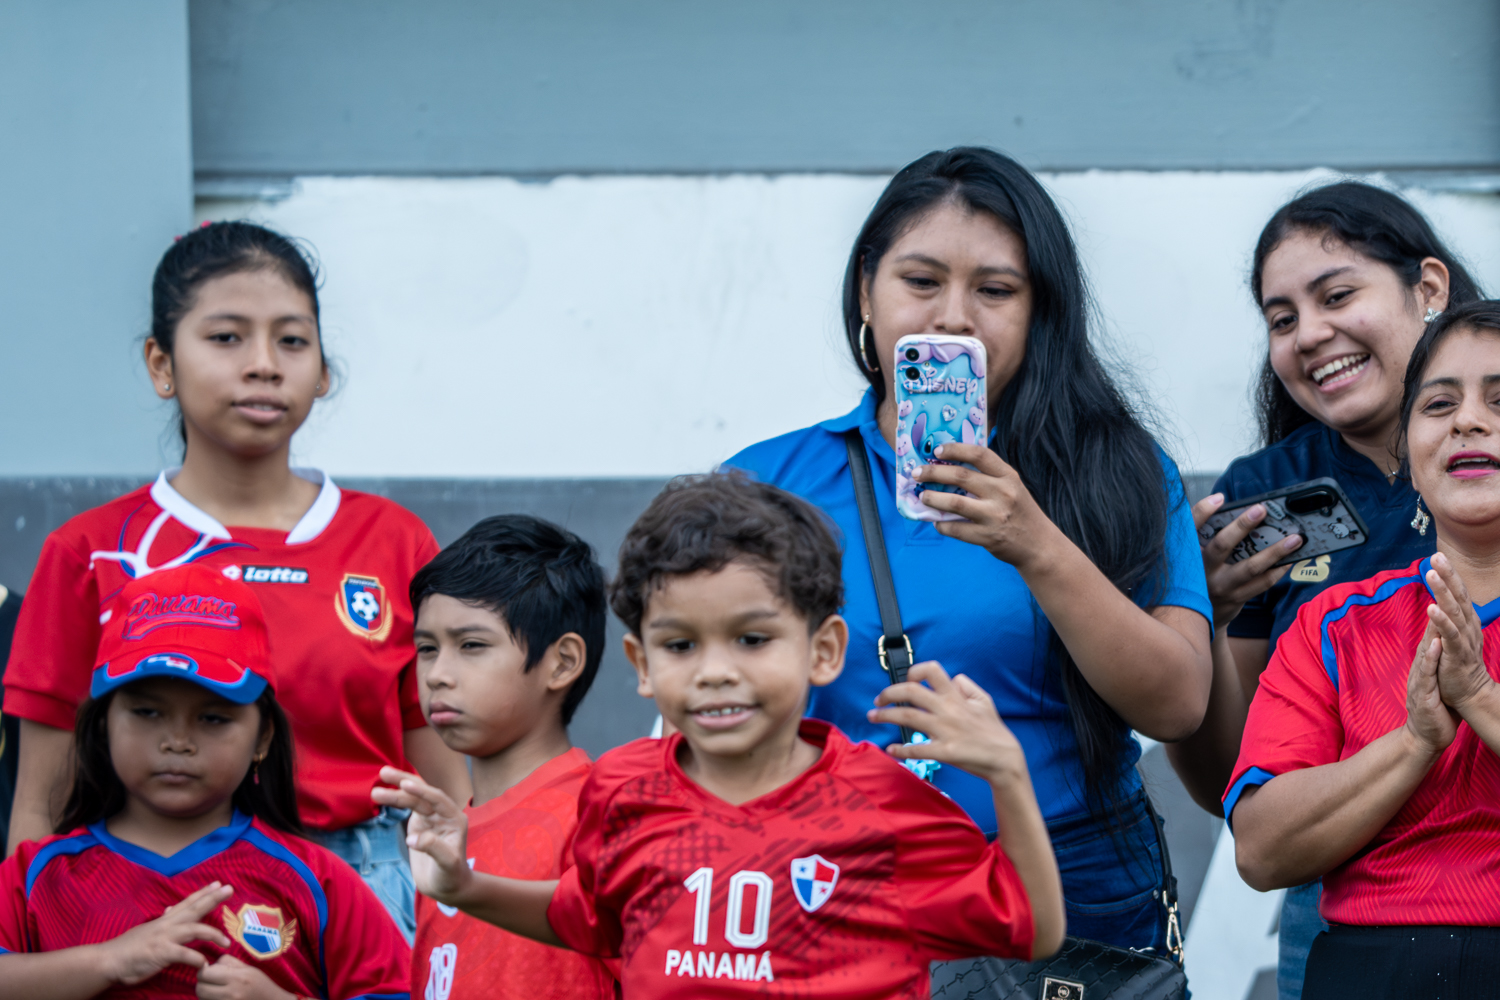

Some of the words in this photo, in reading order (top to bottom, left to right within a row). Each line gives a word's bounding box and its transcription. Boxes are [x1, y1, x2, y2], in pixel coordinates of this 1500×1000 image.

[244, 567, 309, 583] lotto
[1300, 569, 1318, 577] FIFA
[683, 867, 773, 949] 10
[665, 949, 774, 983] PANAMÁ
